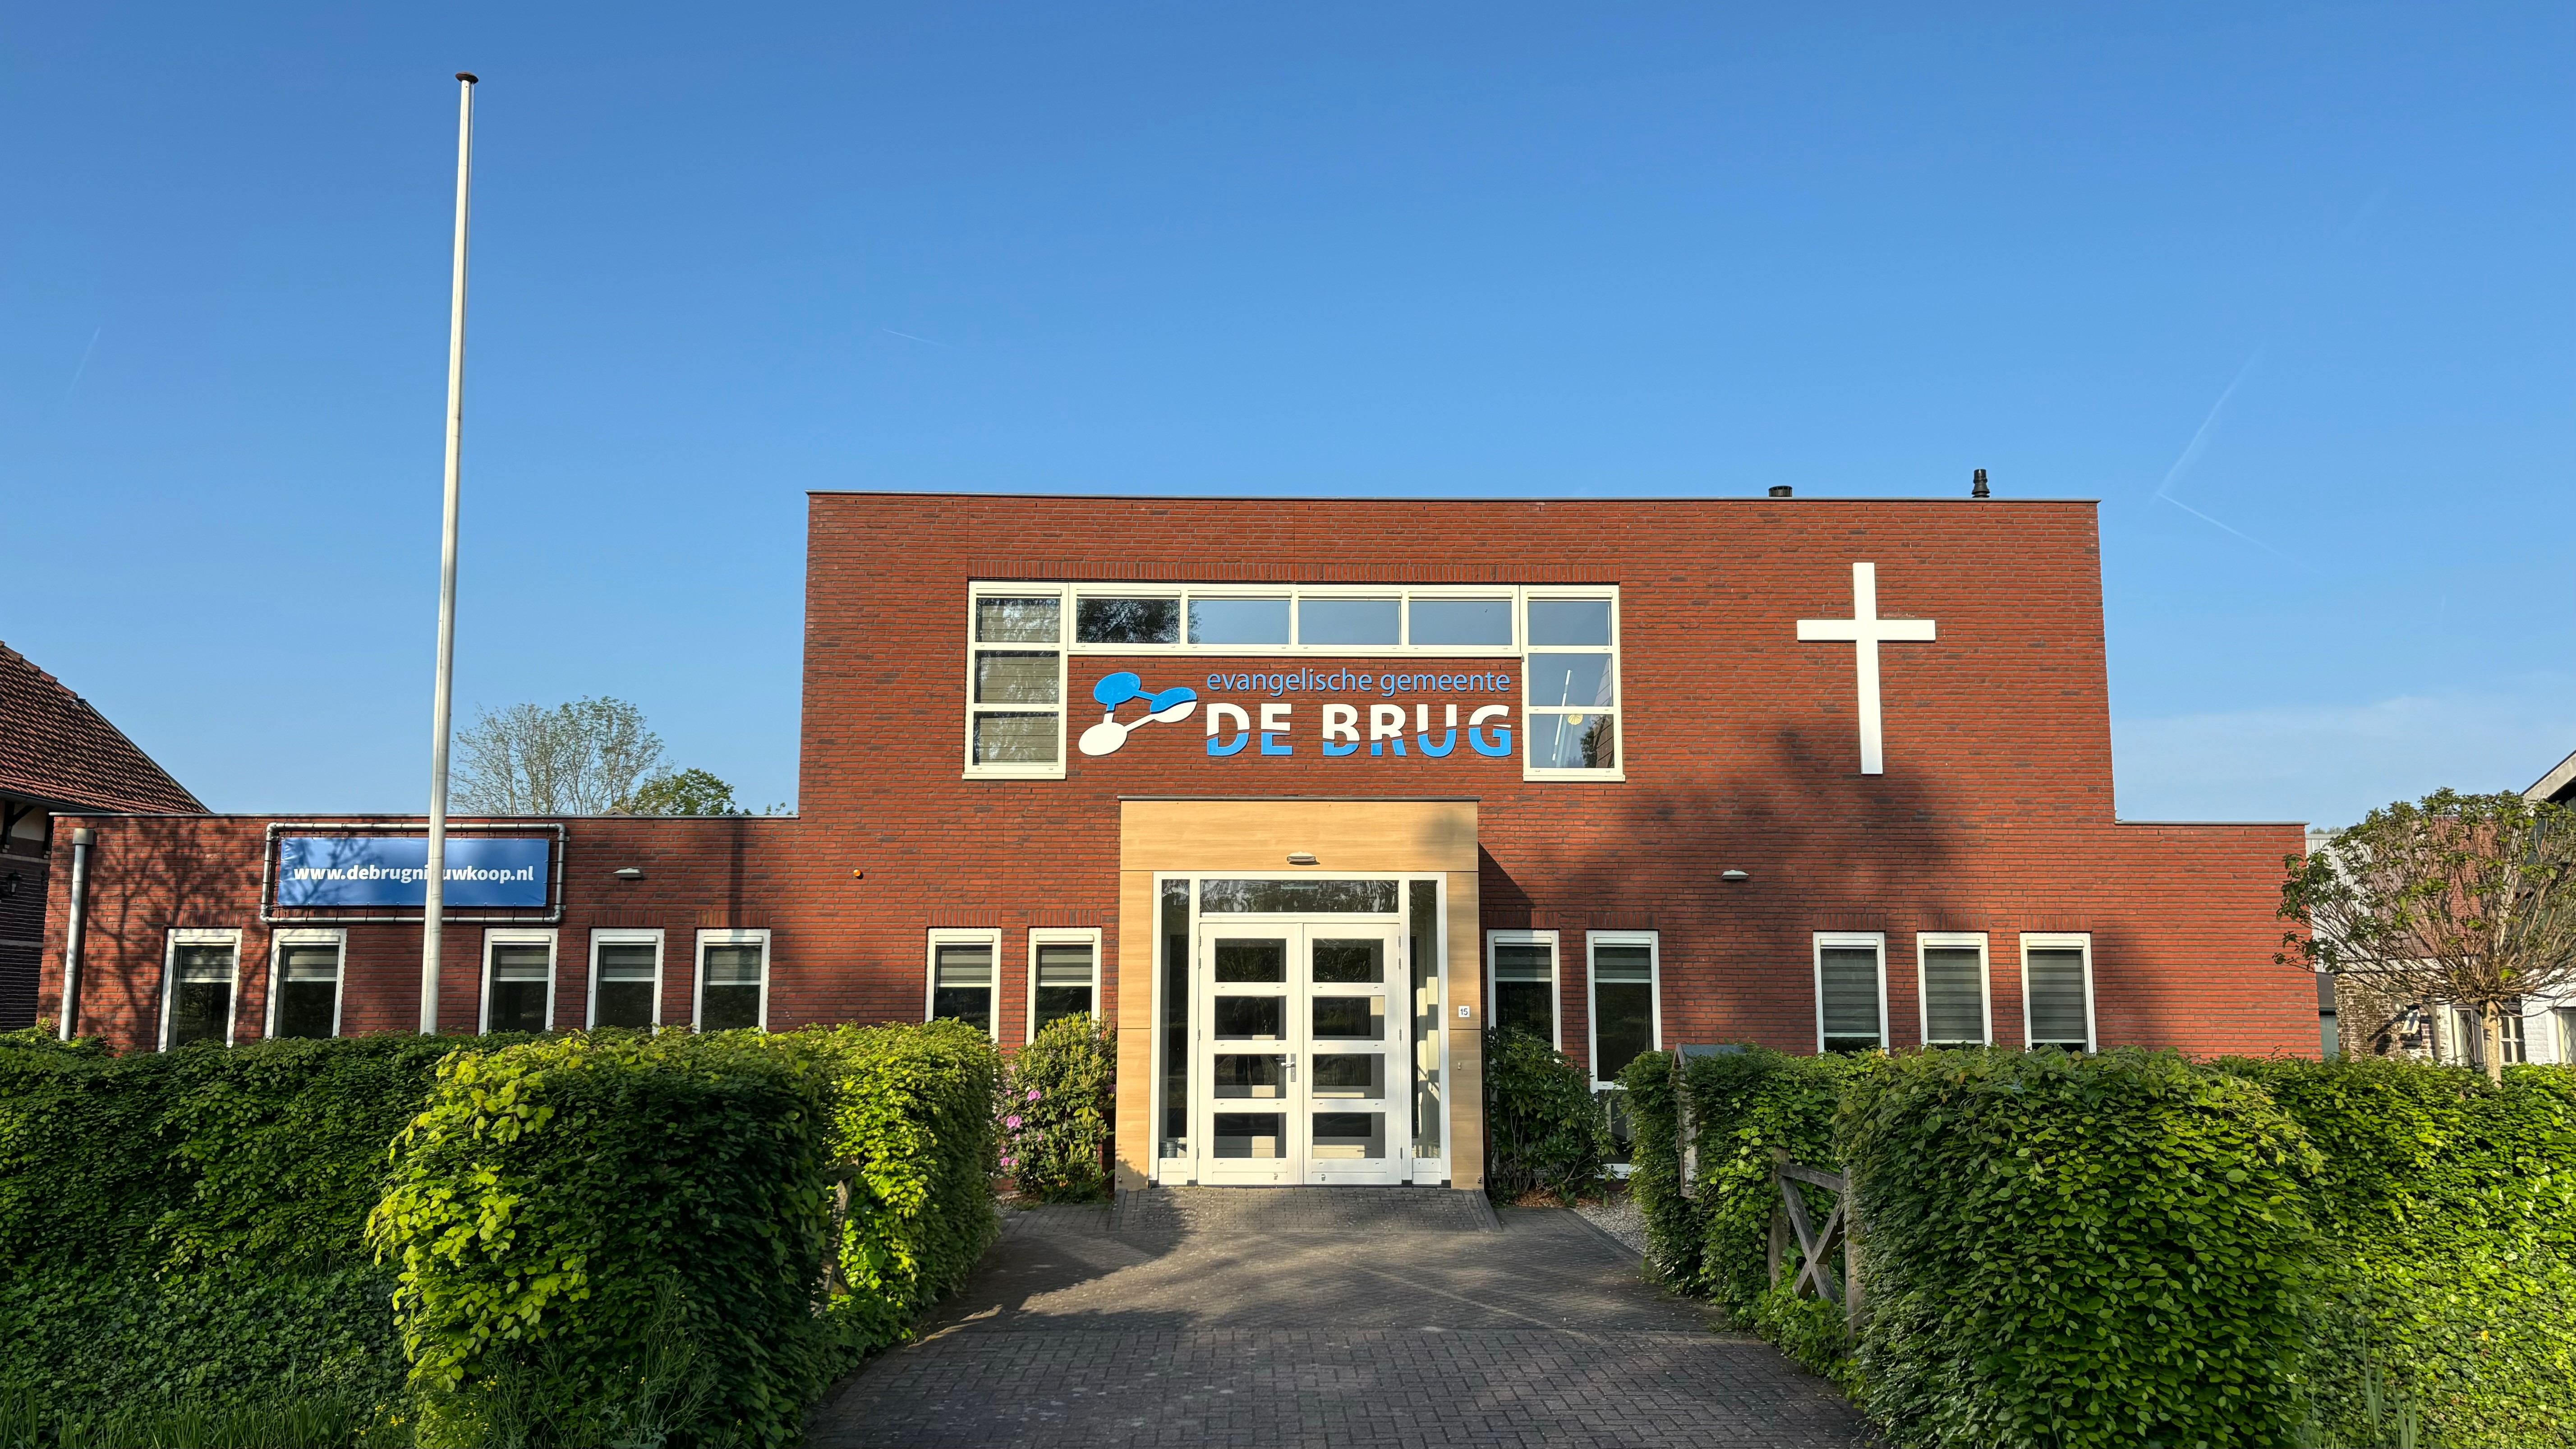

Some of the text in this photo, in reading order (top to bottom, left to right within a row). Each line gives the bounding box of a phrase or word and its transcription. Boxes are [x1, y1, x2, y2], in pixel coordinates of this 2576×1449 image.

[1207, 668, 1510, 697] evangelische gemeente
[1206, 703, 1512, 757] DE BRUG
[294, 865, 534, 884] www.debrugniuwkoop.nl
